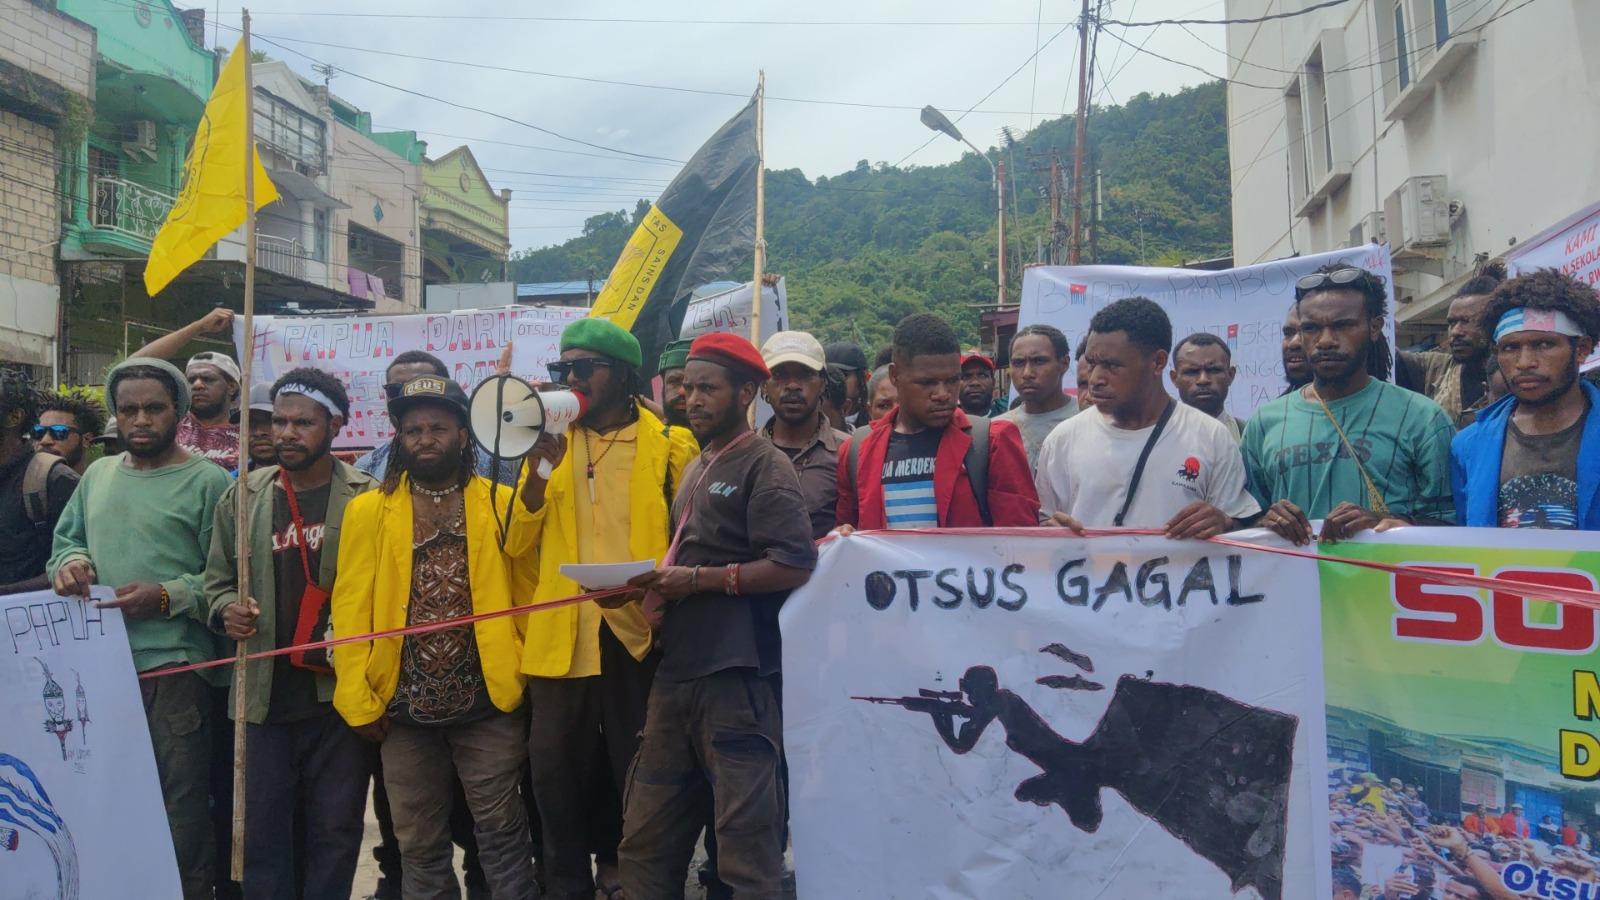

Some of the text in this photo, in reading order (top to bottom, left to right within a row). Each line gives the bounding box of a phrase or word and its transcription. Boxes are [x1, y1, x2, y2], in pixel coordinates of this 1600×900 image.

[1565, 223, 1598, 256] KAMI
[627, 248, 666, 311] SAINS DAN
[284, 321, 394, 362] PAPUA
[517, 323, 560, 337] OTSUS
[865, 554, 1265, 612] OTSUS GAGAL
[5, 597, 105, 654] PAPUA
